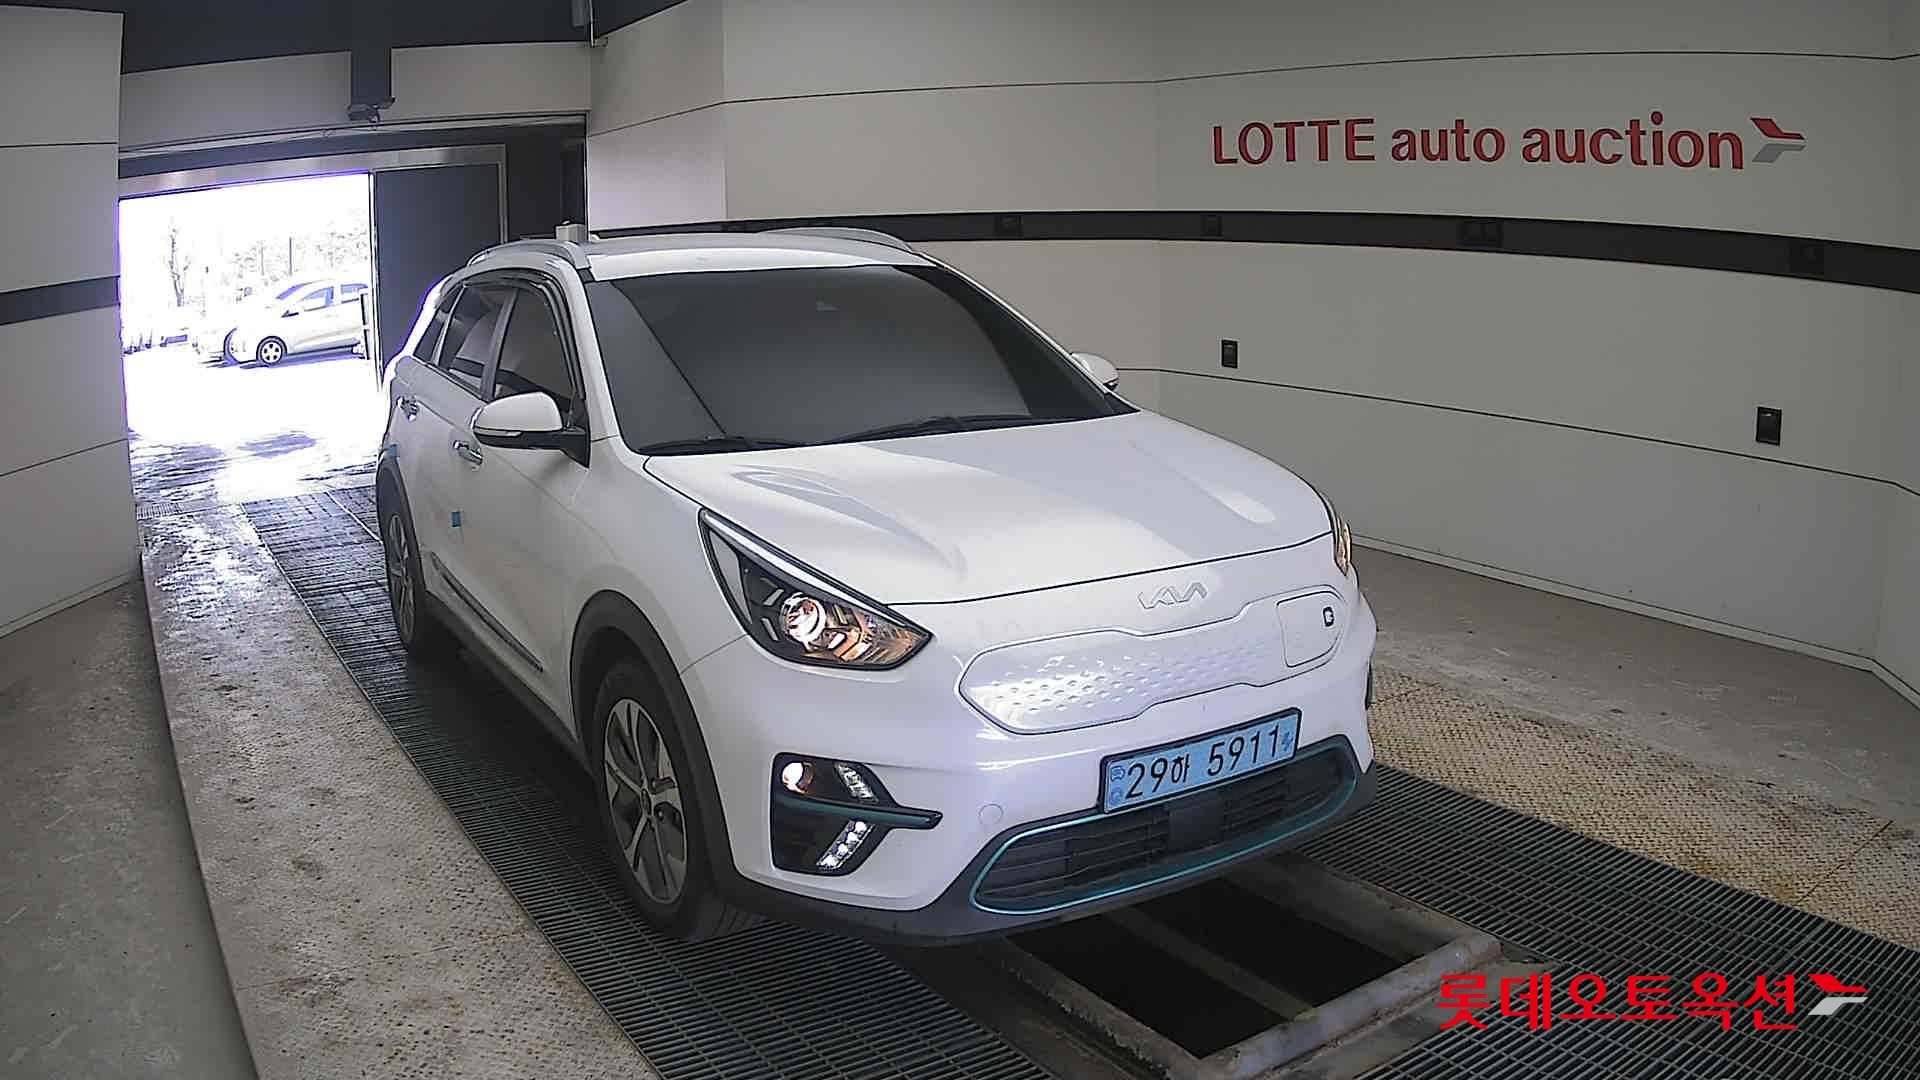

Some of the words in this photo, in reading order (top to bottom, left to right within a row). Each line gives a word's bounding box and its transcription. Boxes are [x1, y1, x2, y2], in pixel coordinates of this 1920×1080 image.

[1213, 117, 1376, 165] LOTTE
[1390, 119, 1506, 163] auto
[1521, 111, 1744, 170] auction
[1124, 753, 1190, 799] 29하
[1207, 724, 1281, 777] 5911
